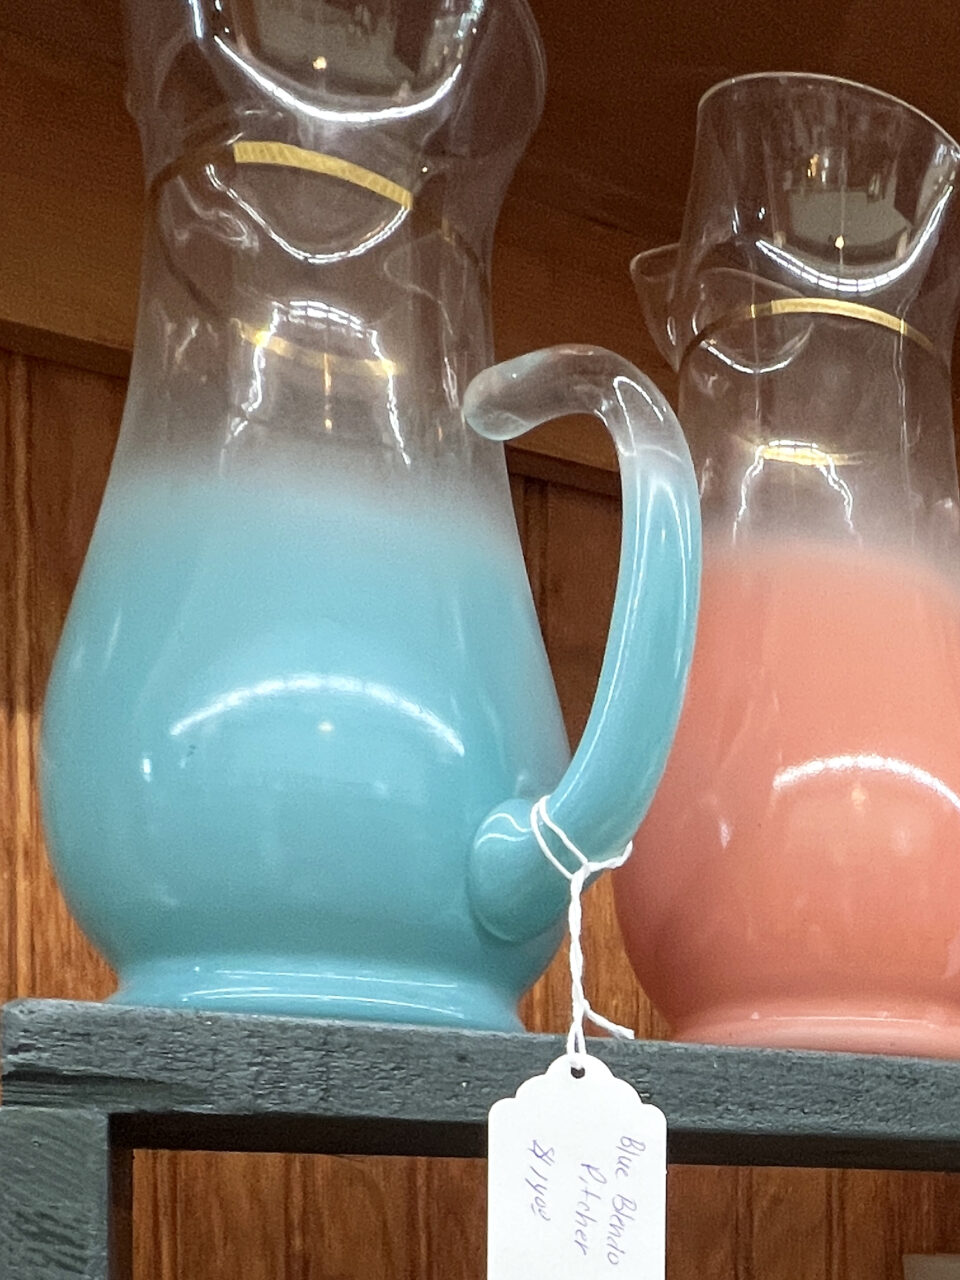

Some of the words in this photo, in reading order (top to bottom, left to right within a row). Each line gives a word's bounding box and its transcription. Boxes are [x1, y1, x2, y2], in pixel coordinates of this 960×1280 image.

[615, 1135, 646, 1179] Blue
[573, 1162, 607, 1256] Pitcher
[606, 1193, 638, 1266] Blendo
